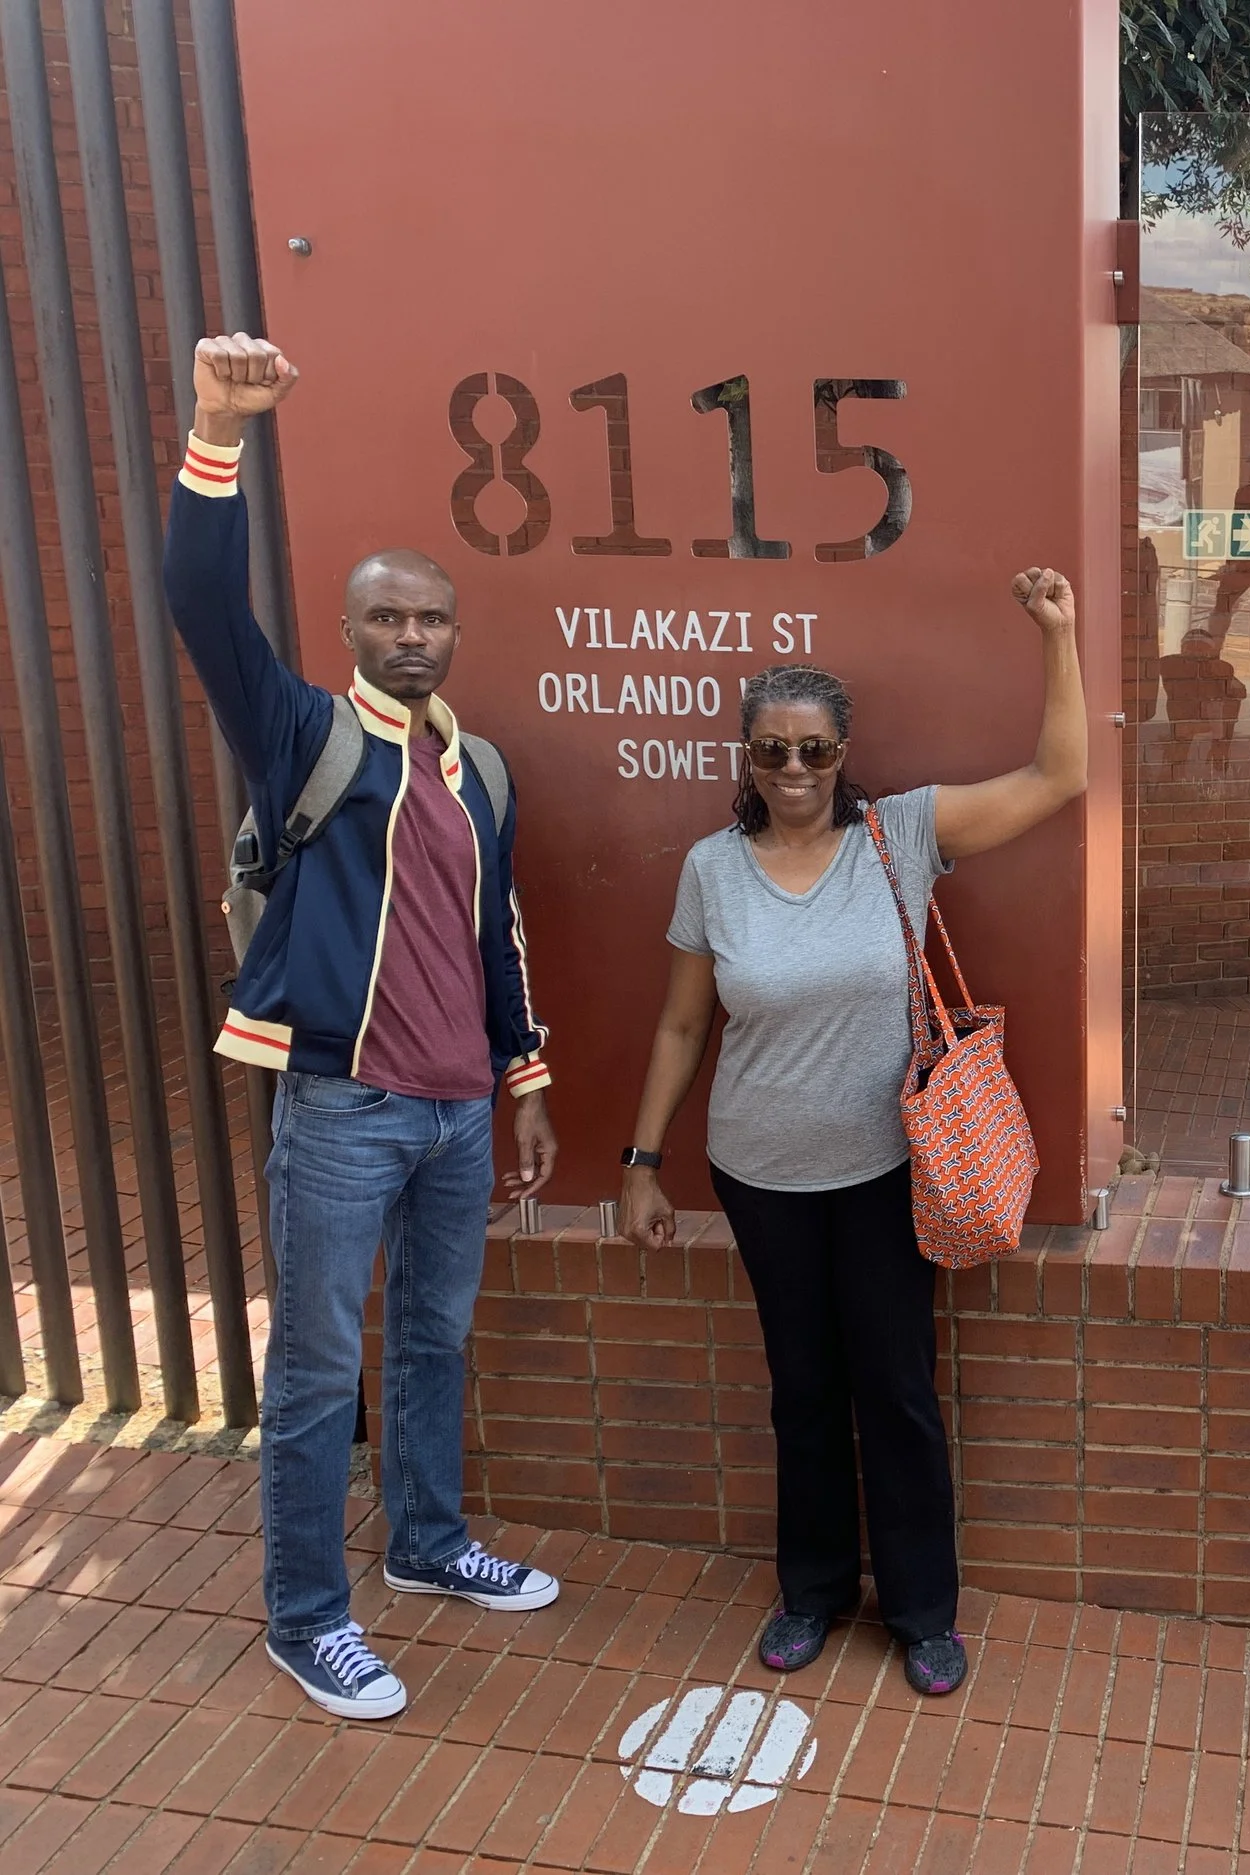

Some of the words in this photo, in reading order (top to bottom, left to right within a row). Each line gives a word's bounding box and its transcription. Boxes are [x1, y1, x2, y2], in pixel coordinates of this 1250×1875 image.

[448, 371, 913, 563] 8115
[555, 606, 754, 653] VILAKAZI
[772, 612, 818, 655] ST
[538, 671, 721, 717] ORLANDO
[617, 738, 744, 781] SOWET
